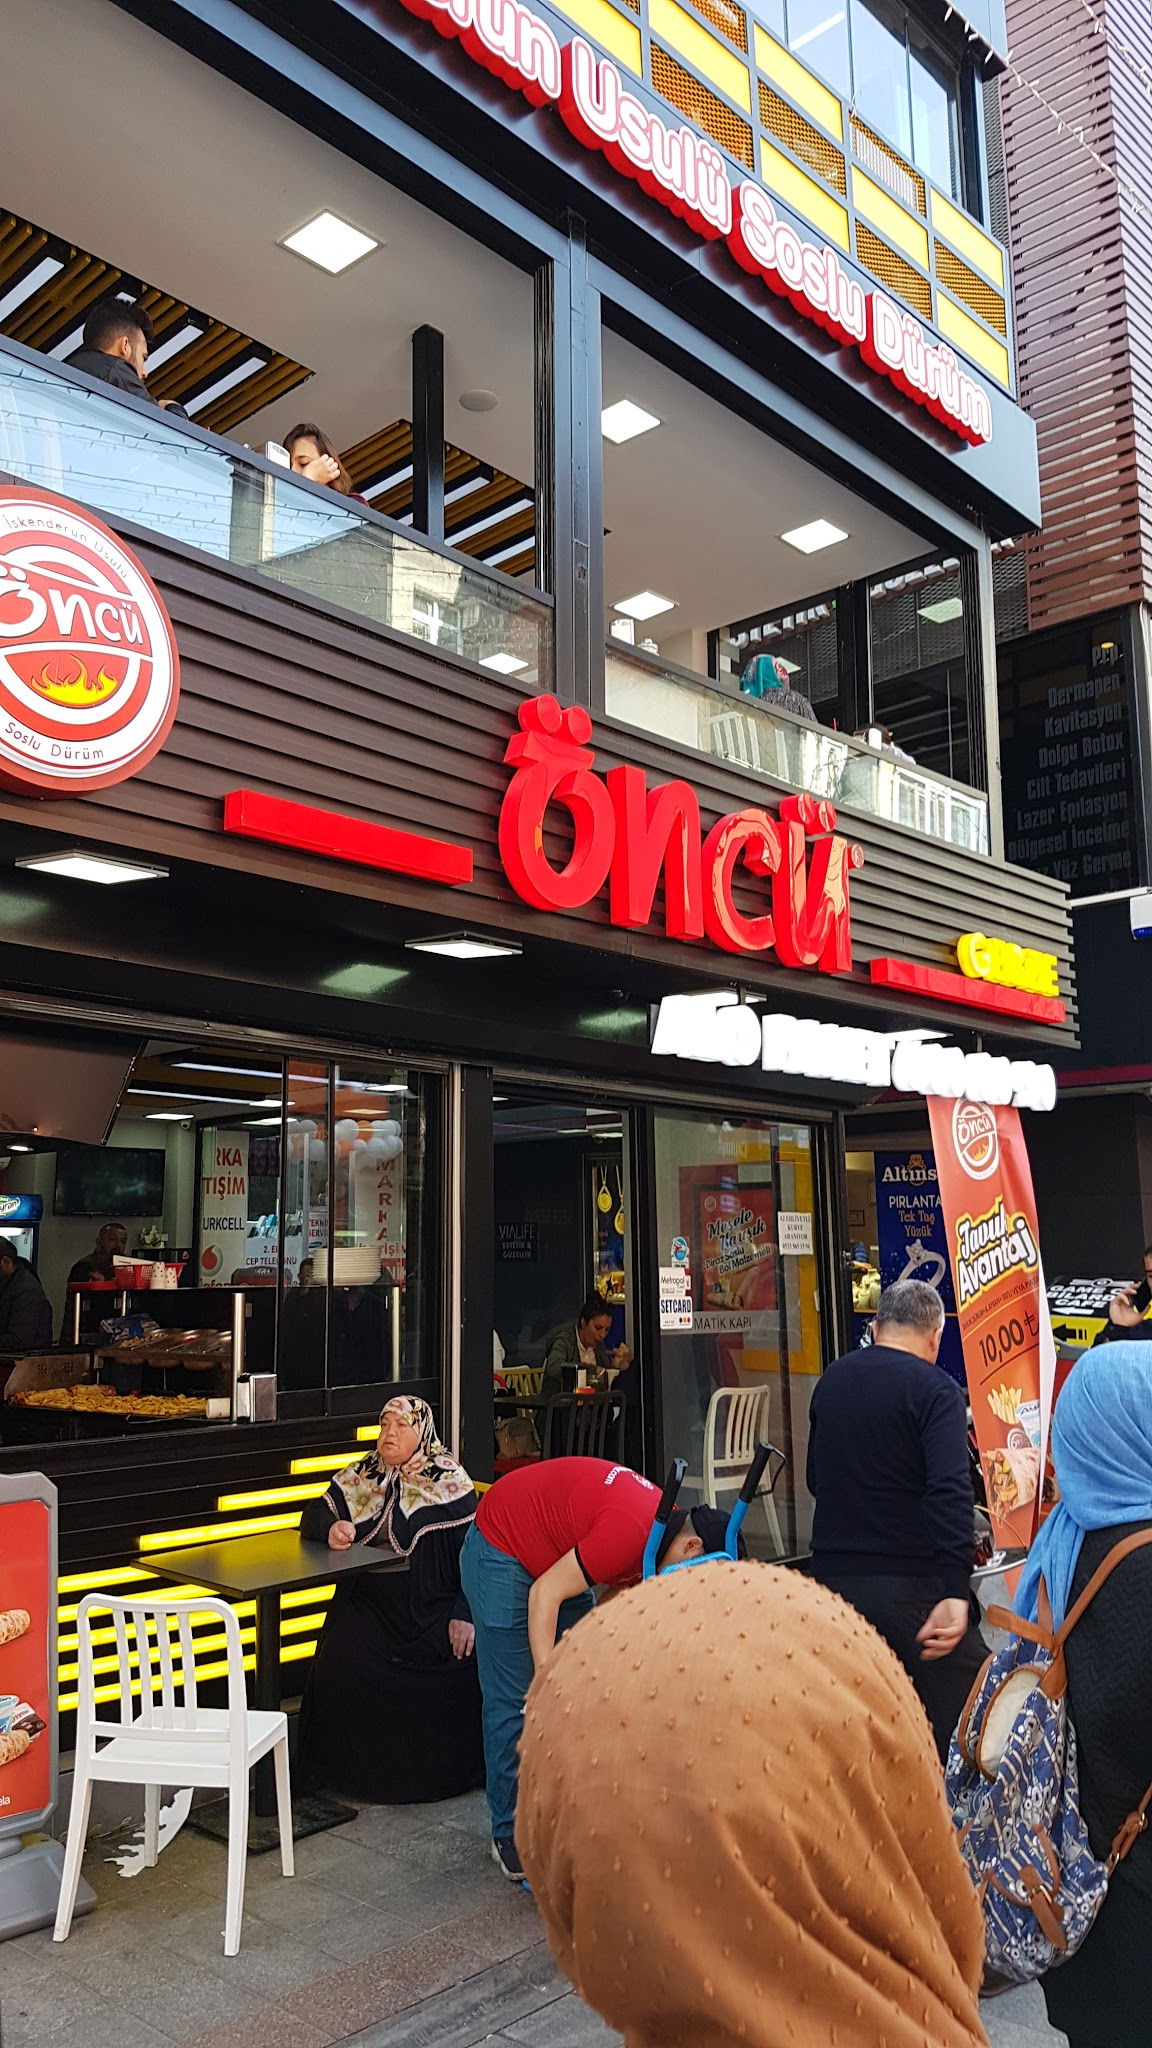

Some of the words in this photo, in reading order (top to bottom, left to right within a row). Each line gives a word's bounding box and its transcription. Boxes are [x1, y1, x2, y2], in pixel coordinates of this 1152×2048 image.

[571, 35, 732, 235] Usulü
[739, 178, 867, 343] Soslu
[872, 289, 993, 443] Dürüm
[2, 513, 87, 543] İskenderun
[1048, 672, 1120, 708] Dermapen
[1045, 703, 1122, 738] Kavitasyon
[5, 722, 41, 750] Soslu
[51, 743, 104, 760] Dürüm
[1082, 732, 1124, 757] Botox
[1017, 807, 1056, 831] Lazer
[959, 1217, 1037, 1306] Avantaj
[661, 1299, 691, 1314] SETCARD
[1047, 1291, 1118, 1301] BILARD
[729, 1316, 752, 1329] KAPI
[979, 1318, 1024, 1367] 10,00
